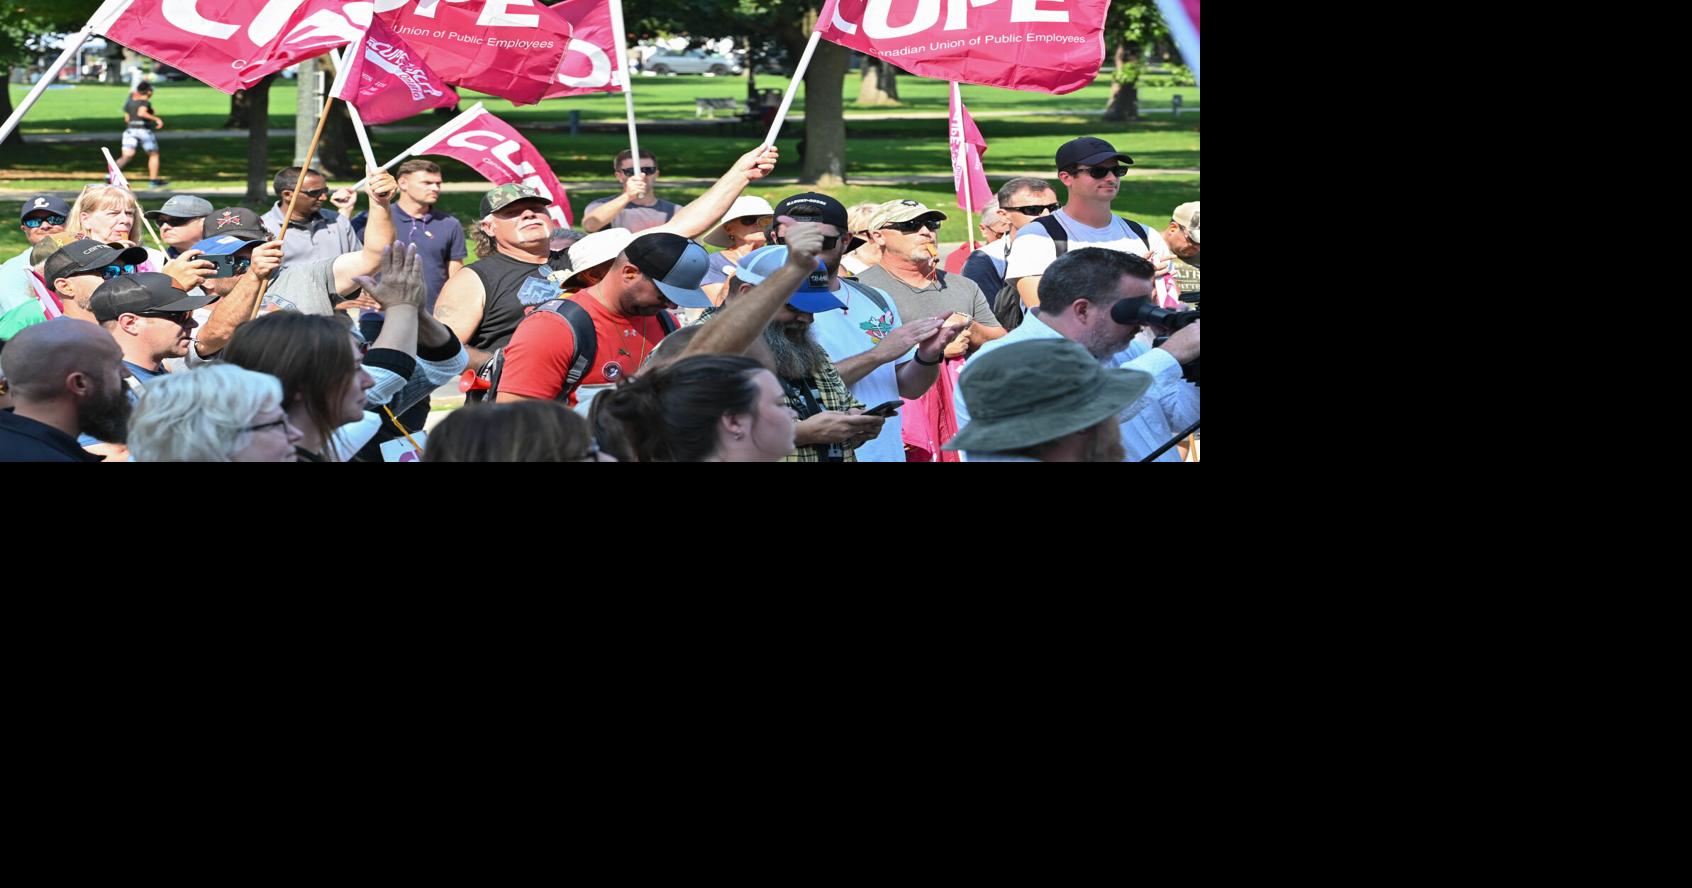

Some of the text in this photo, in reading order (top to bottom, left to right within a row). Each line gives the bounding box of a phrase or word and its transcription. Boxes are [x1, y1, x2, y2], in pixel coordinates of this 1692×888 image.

[393, 25, 554, 50] Union of Public Employees
[930, 39, 965, 51] Union
[969, 37, 981, 46] of
[985, 34, 1024, 45] Public
[1026, 33, 1086, 45] Employees
